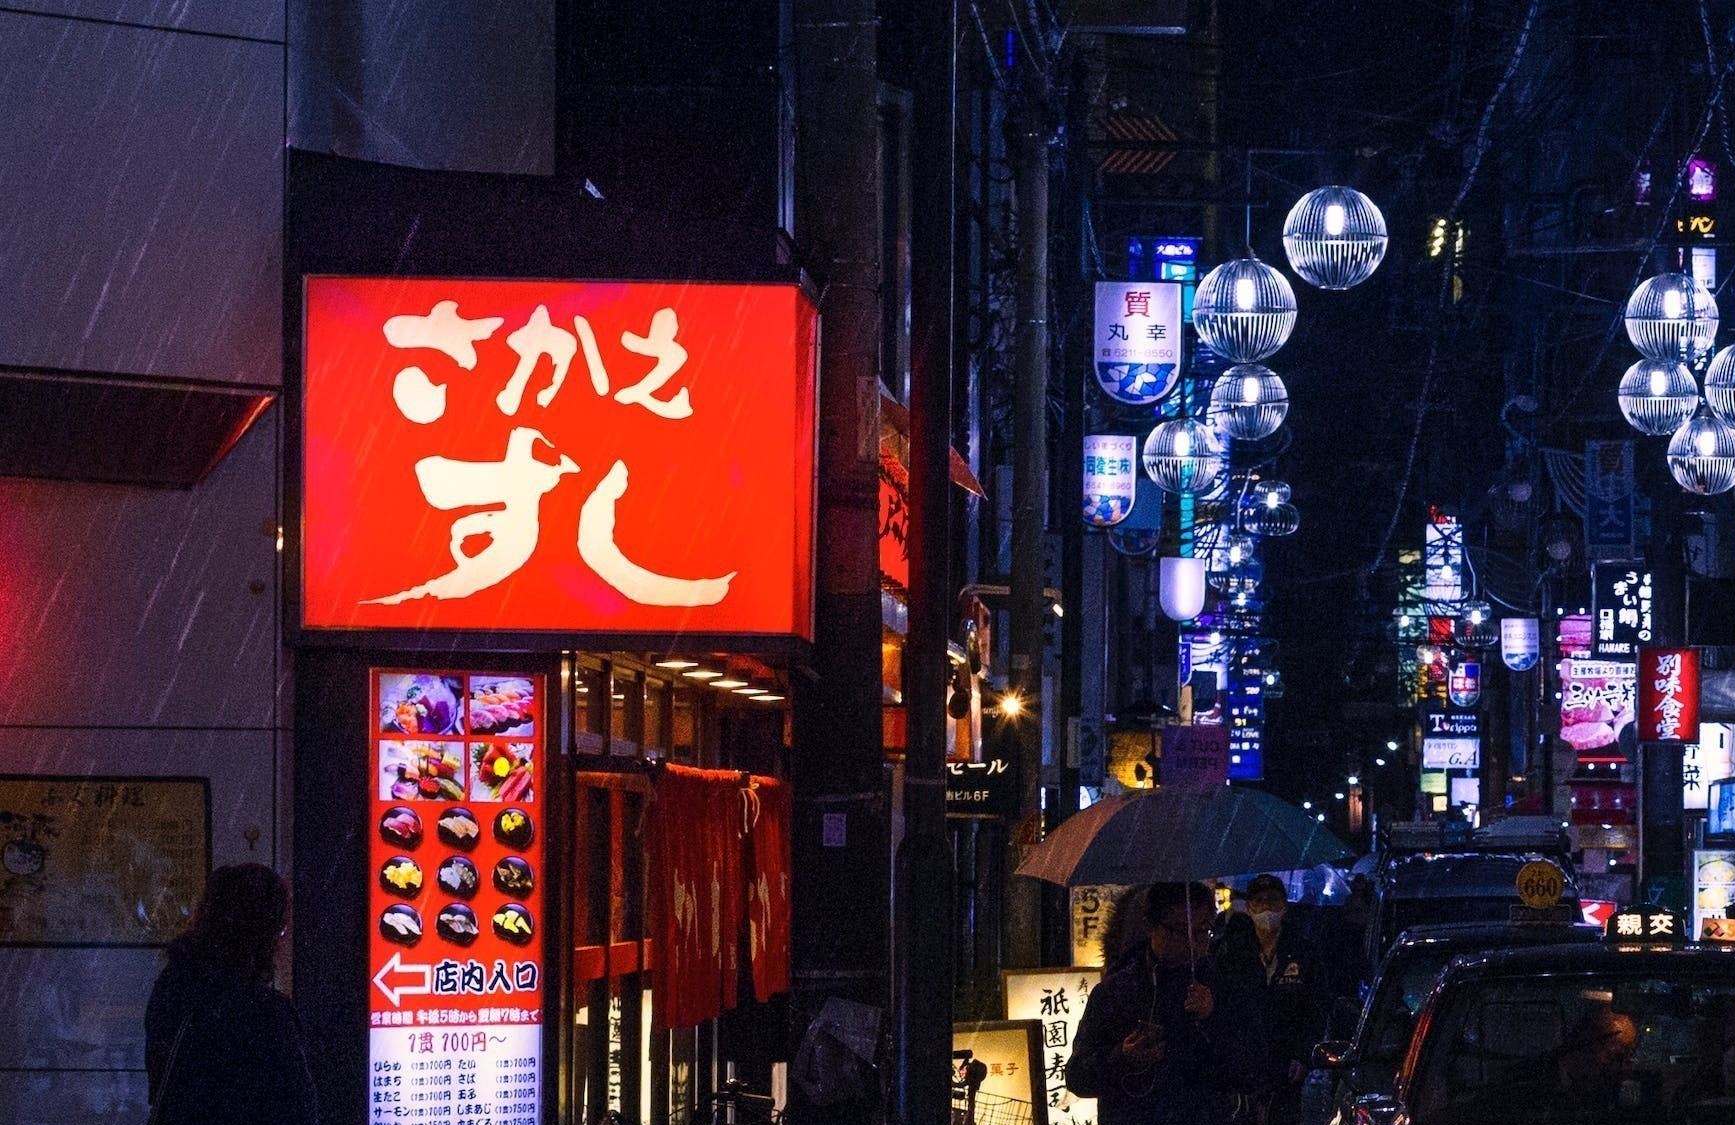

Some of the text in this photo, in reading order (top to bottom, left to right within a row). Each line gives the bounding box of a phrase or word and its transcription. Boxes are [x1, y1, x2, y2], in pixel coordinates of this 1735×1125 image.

[1124, 291, 1151, 318] 質
[383, 300, 693, 424] さかえ
[358, 426, 738, 607] すし
[1654, 653, 1684, 740] 別味食堂
[1617, 913, 1674, 936] 親交
[434, 960, 538, 994] 店内入口
[371, 1011, 413, 1025] 営業時間
[374, 1107, 410, 1118] サーモン
